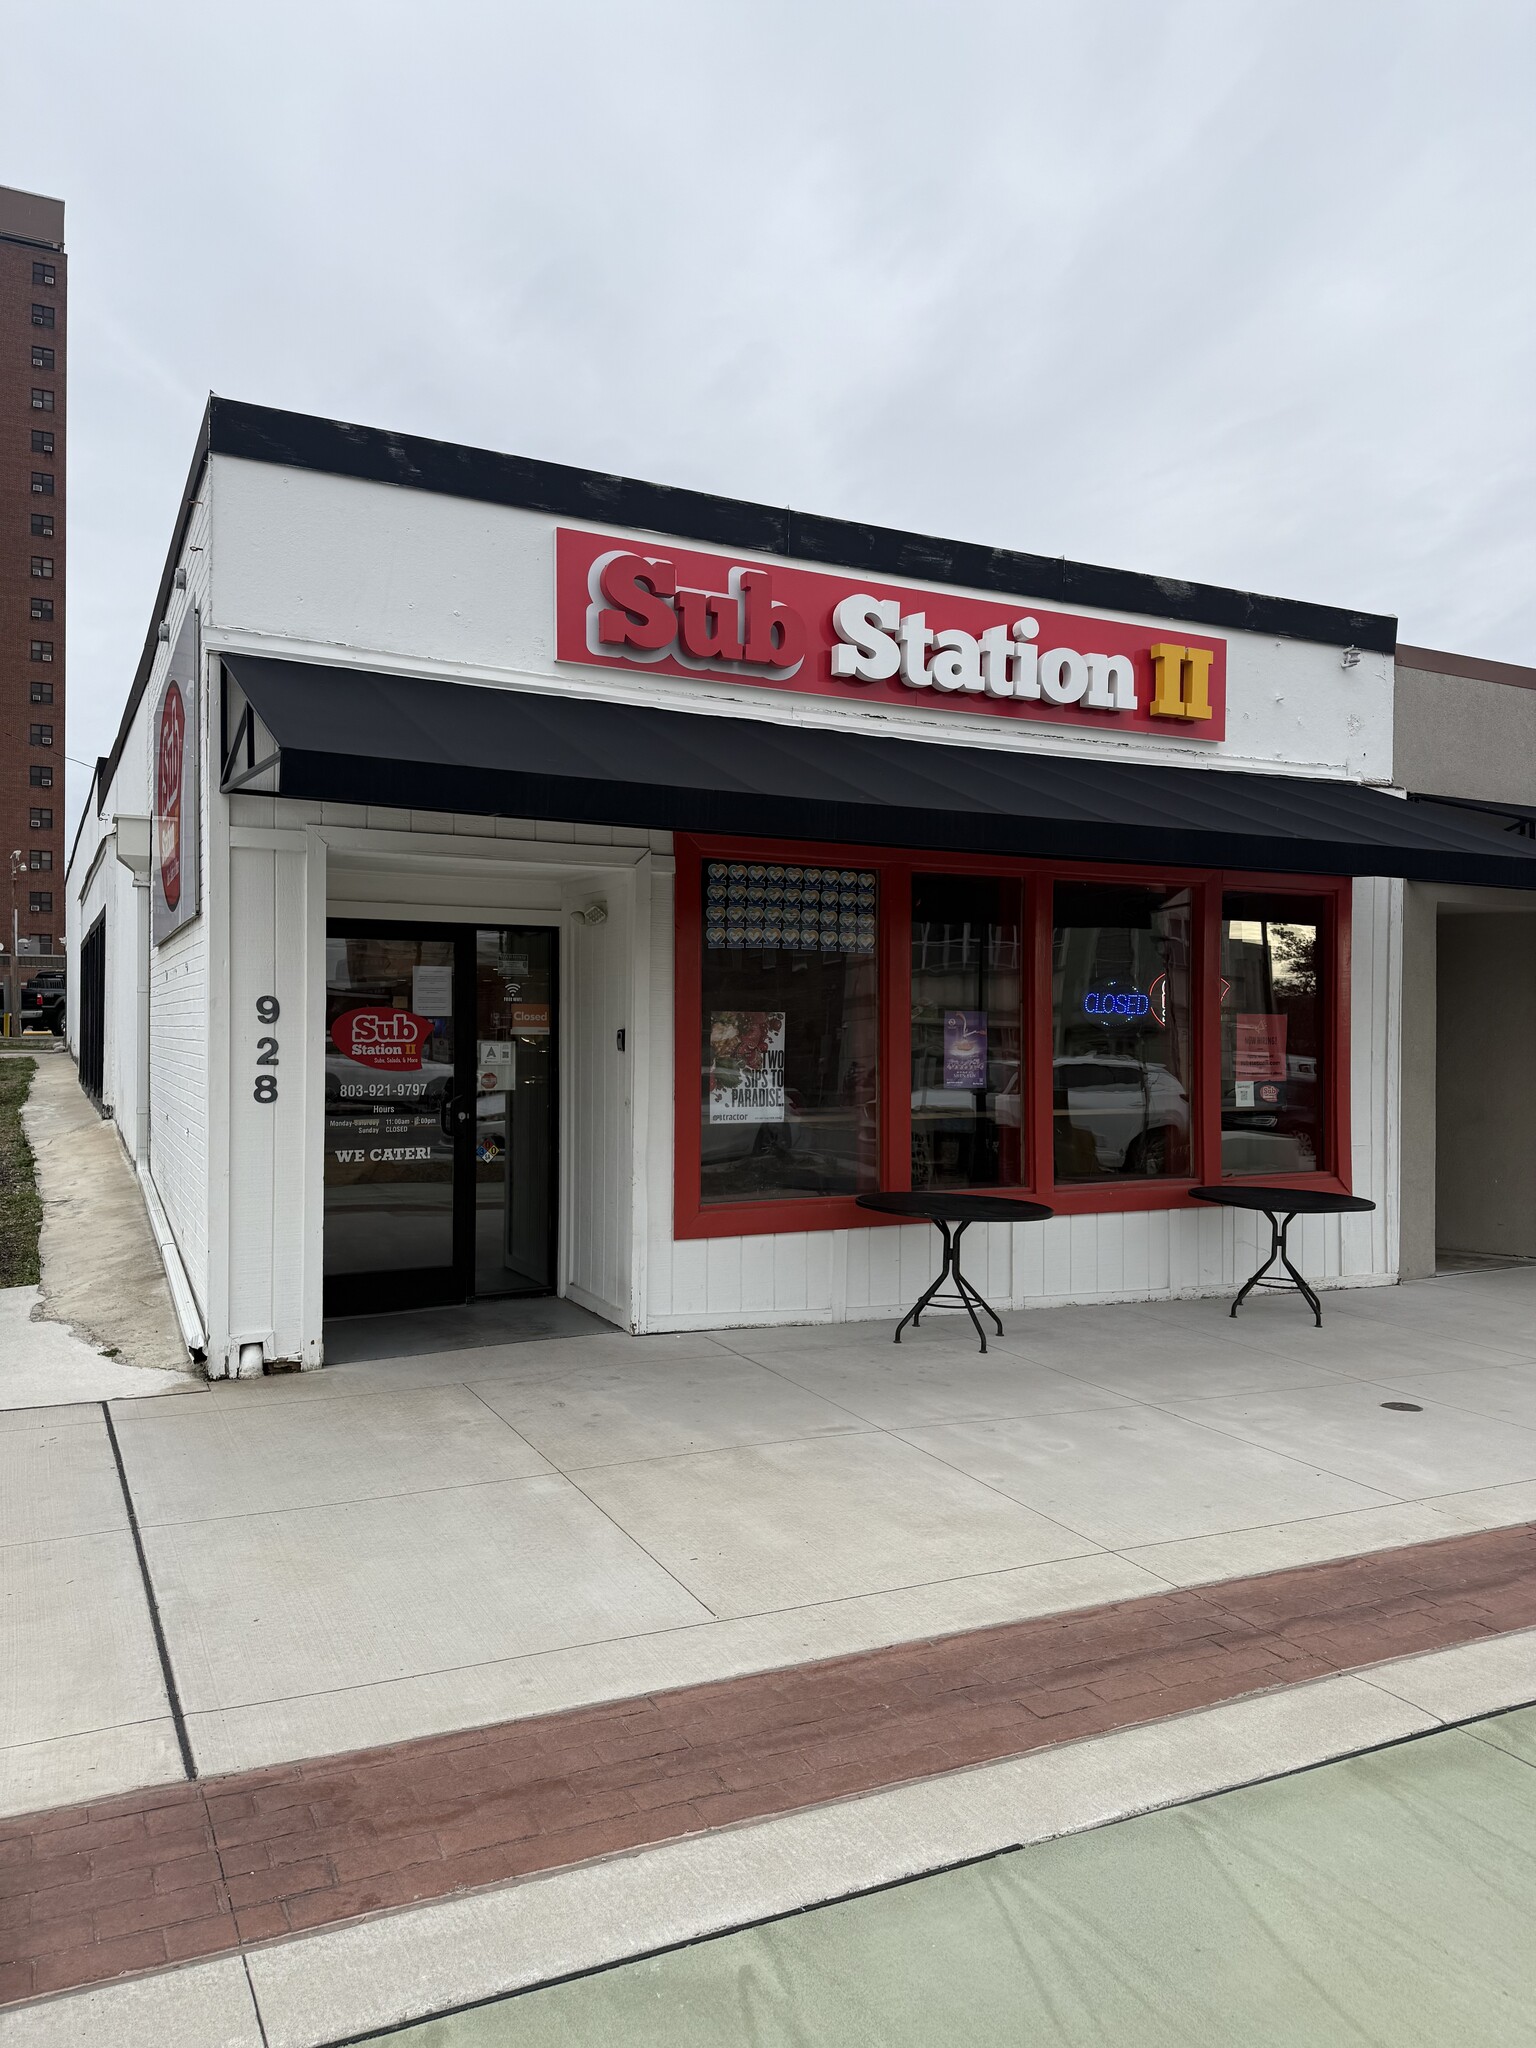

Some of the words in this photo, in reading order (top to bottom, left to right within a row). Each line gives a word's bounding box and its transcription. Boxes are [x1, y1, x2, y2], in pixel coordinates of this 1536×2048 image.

[588, 550, 802, 679] Sub
[831, 593, 1138, 711] Station
[1150, 642, 1213, 720] II
[1084, 992, 1149, 1015] CLOSED
[513, 1010, 548, 1022] Closed
[351, 1013, 418, 1043] Sub
[351, 1043, 402, 1055] Station
[405, 1044, 416, 1055] II
[486, 1046, 496, 1058] A
[762, 1049, 784, 1069] TWO
[744, 1069, 768, 1088] SIPS
[770, 1069, 784, 1088] TO
[339, 1083, 428, 1098] 803-921-9797
[731, 1088, 785, 1107] PARADISE.
[373, 1105, 395, 1114] Hours
[334, 1149, 365, 1163] WE
[369, 1147, 431, 1162] CATER!
